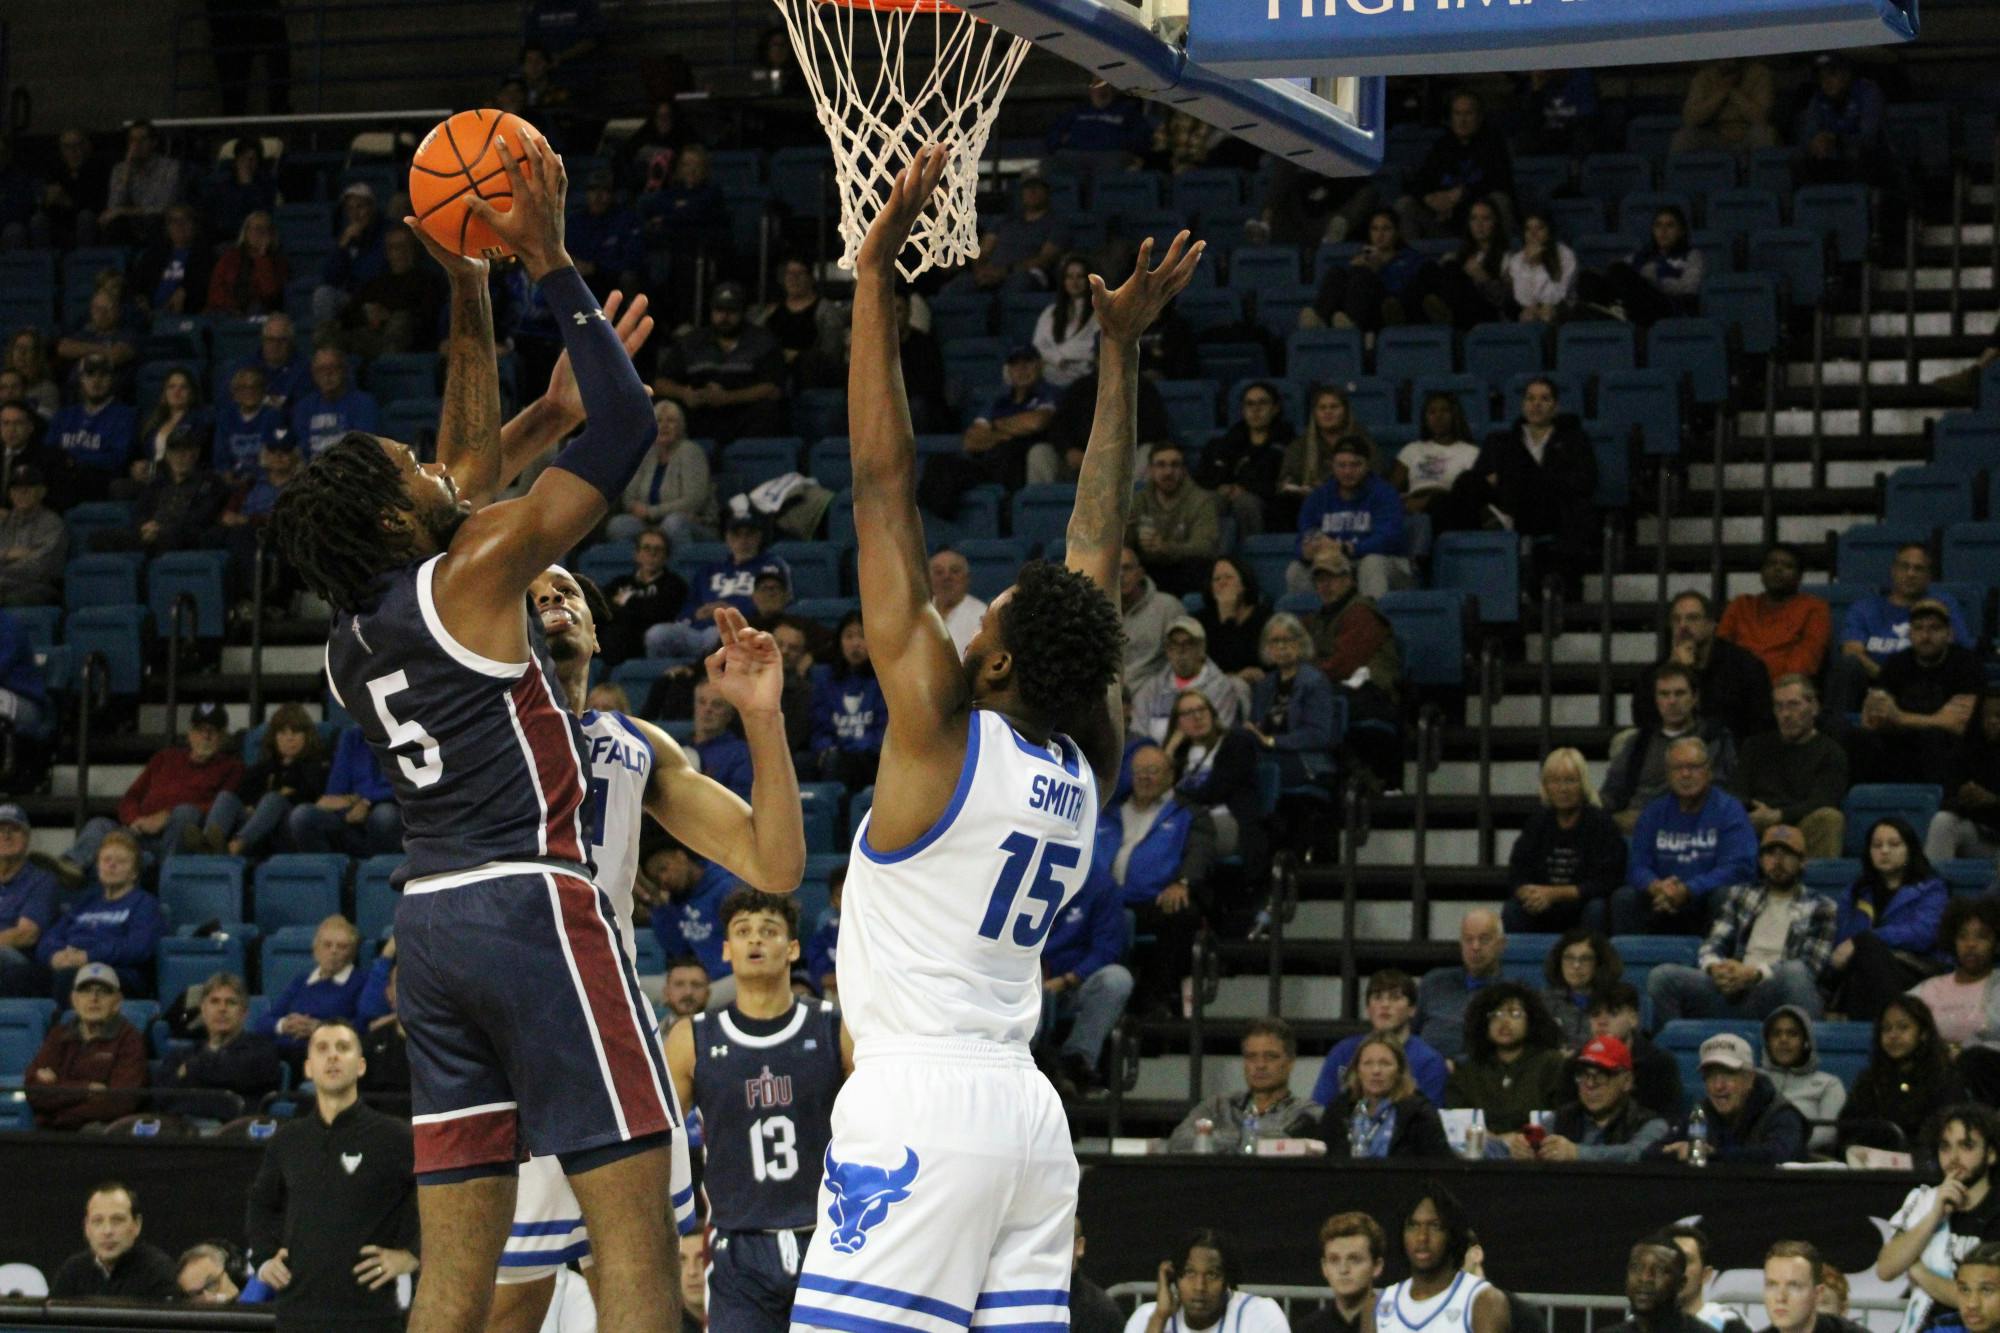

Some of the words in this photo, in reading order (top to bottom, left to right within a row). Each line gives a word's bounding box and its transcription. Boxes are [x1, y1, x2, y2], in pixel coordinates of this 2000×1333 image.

[366, 669, 443, 789] 5
[1029, 774, 1086, 822] SMITH
[978, 830, 1081, 947] 15
[745, 1075, 794, 1109] FDU
[749, 1115, 799, 1182] 13
